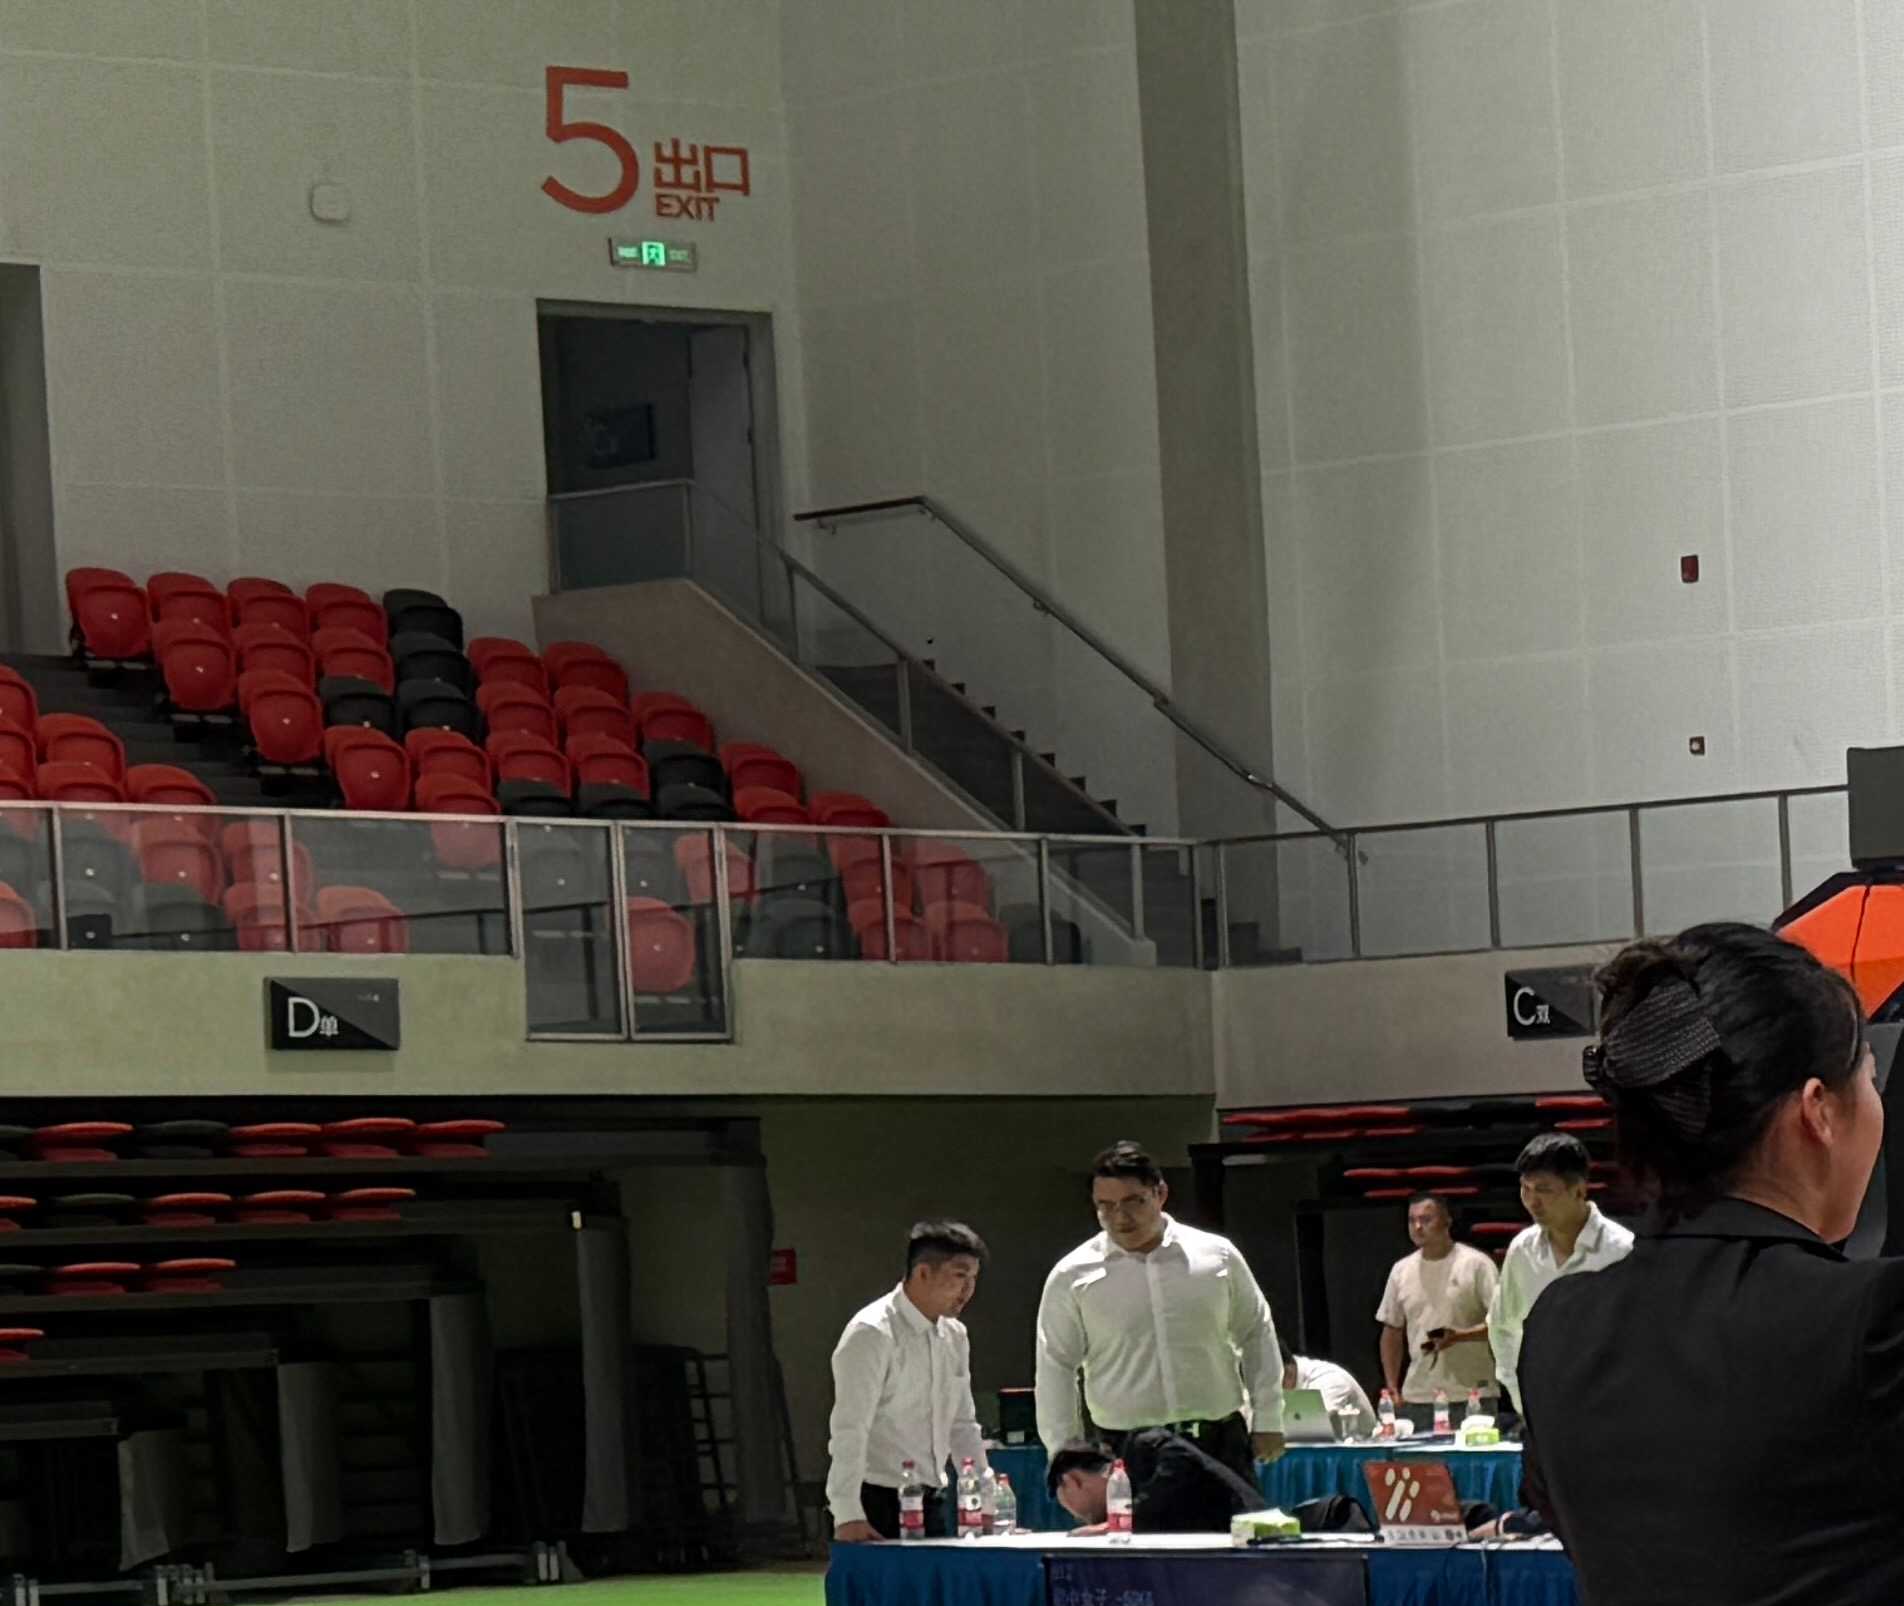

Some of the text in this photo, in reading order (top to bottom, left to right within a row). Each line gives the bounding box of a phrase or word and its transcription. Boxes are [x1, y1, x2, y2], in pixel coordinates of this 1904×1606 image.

[541, 66, 639, 213] 5
[653, 138, 750, 197] 出口
[656, 194, 719, 221] EXIT
